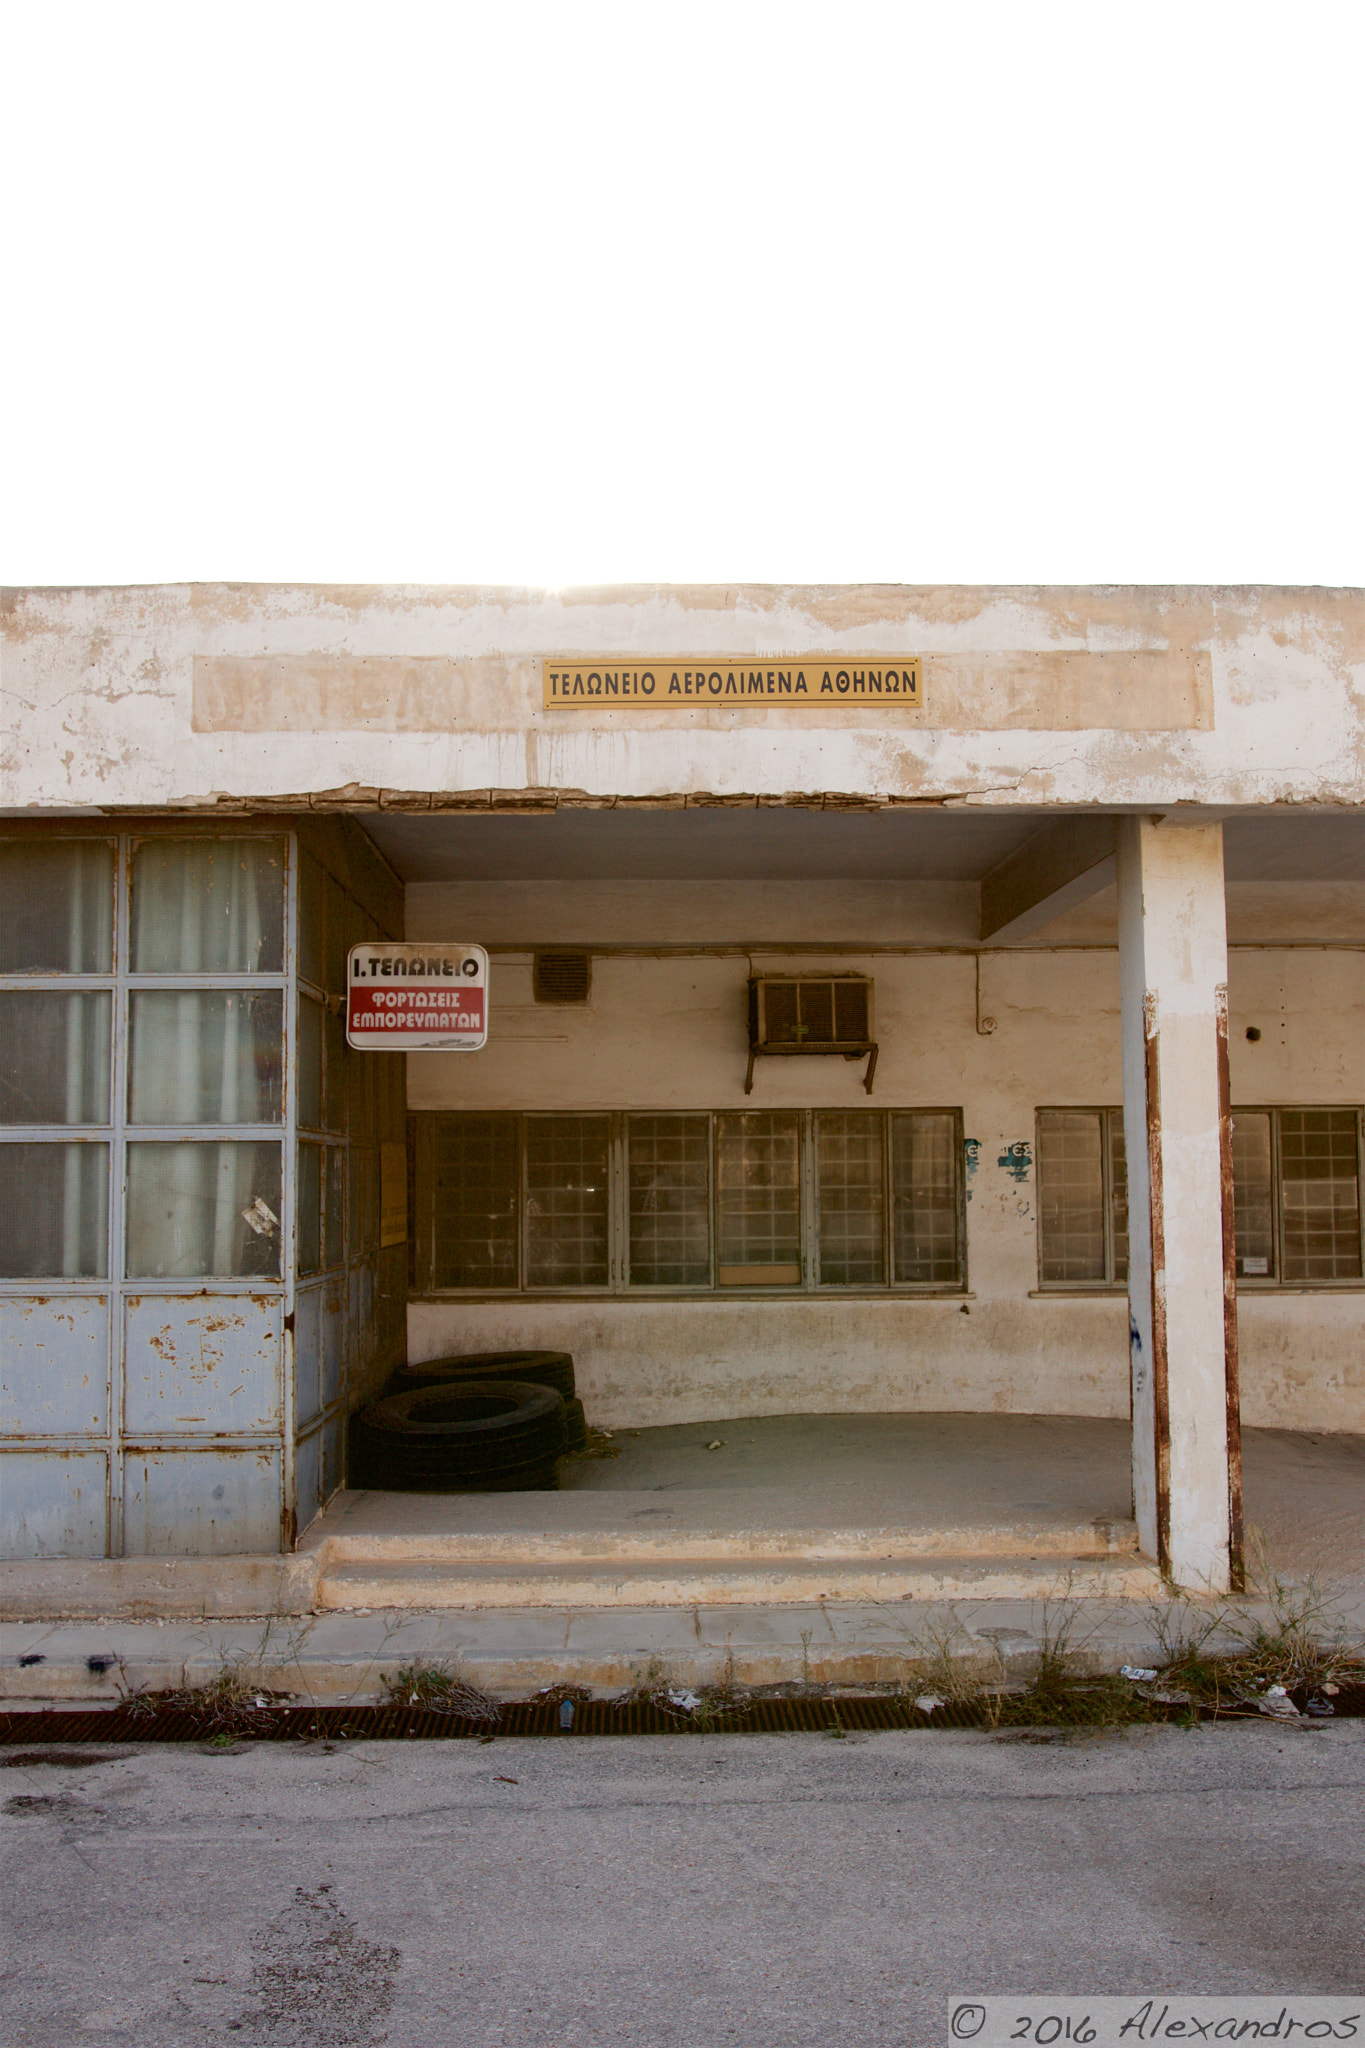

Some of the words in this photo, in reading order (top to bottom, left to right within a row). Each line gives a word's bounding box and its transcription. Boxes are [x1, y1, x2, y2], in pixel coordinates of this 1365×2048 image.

[549, 671, 656, 696] ΤΕΛΩΝΕΙΟ
[668, 670, 808, 695] ΑΕΡΟΛΙΜΕΝΑ
[820, 669, 917, 694] ΑΘΗΝΩΝ
[371, 991, 460, 1008] ΦΟΡΤΩΣΕΙΣ
[352, 1012, 481, 1029] ΕΜΠΟΡΕΥΜΑΤΩΝ
